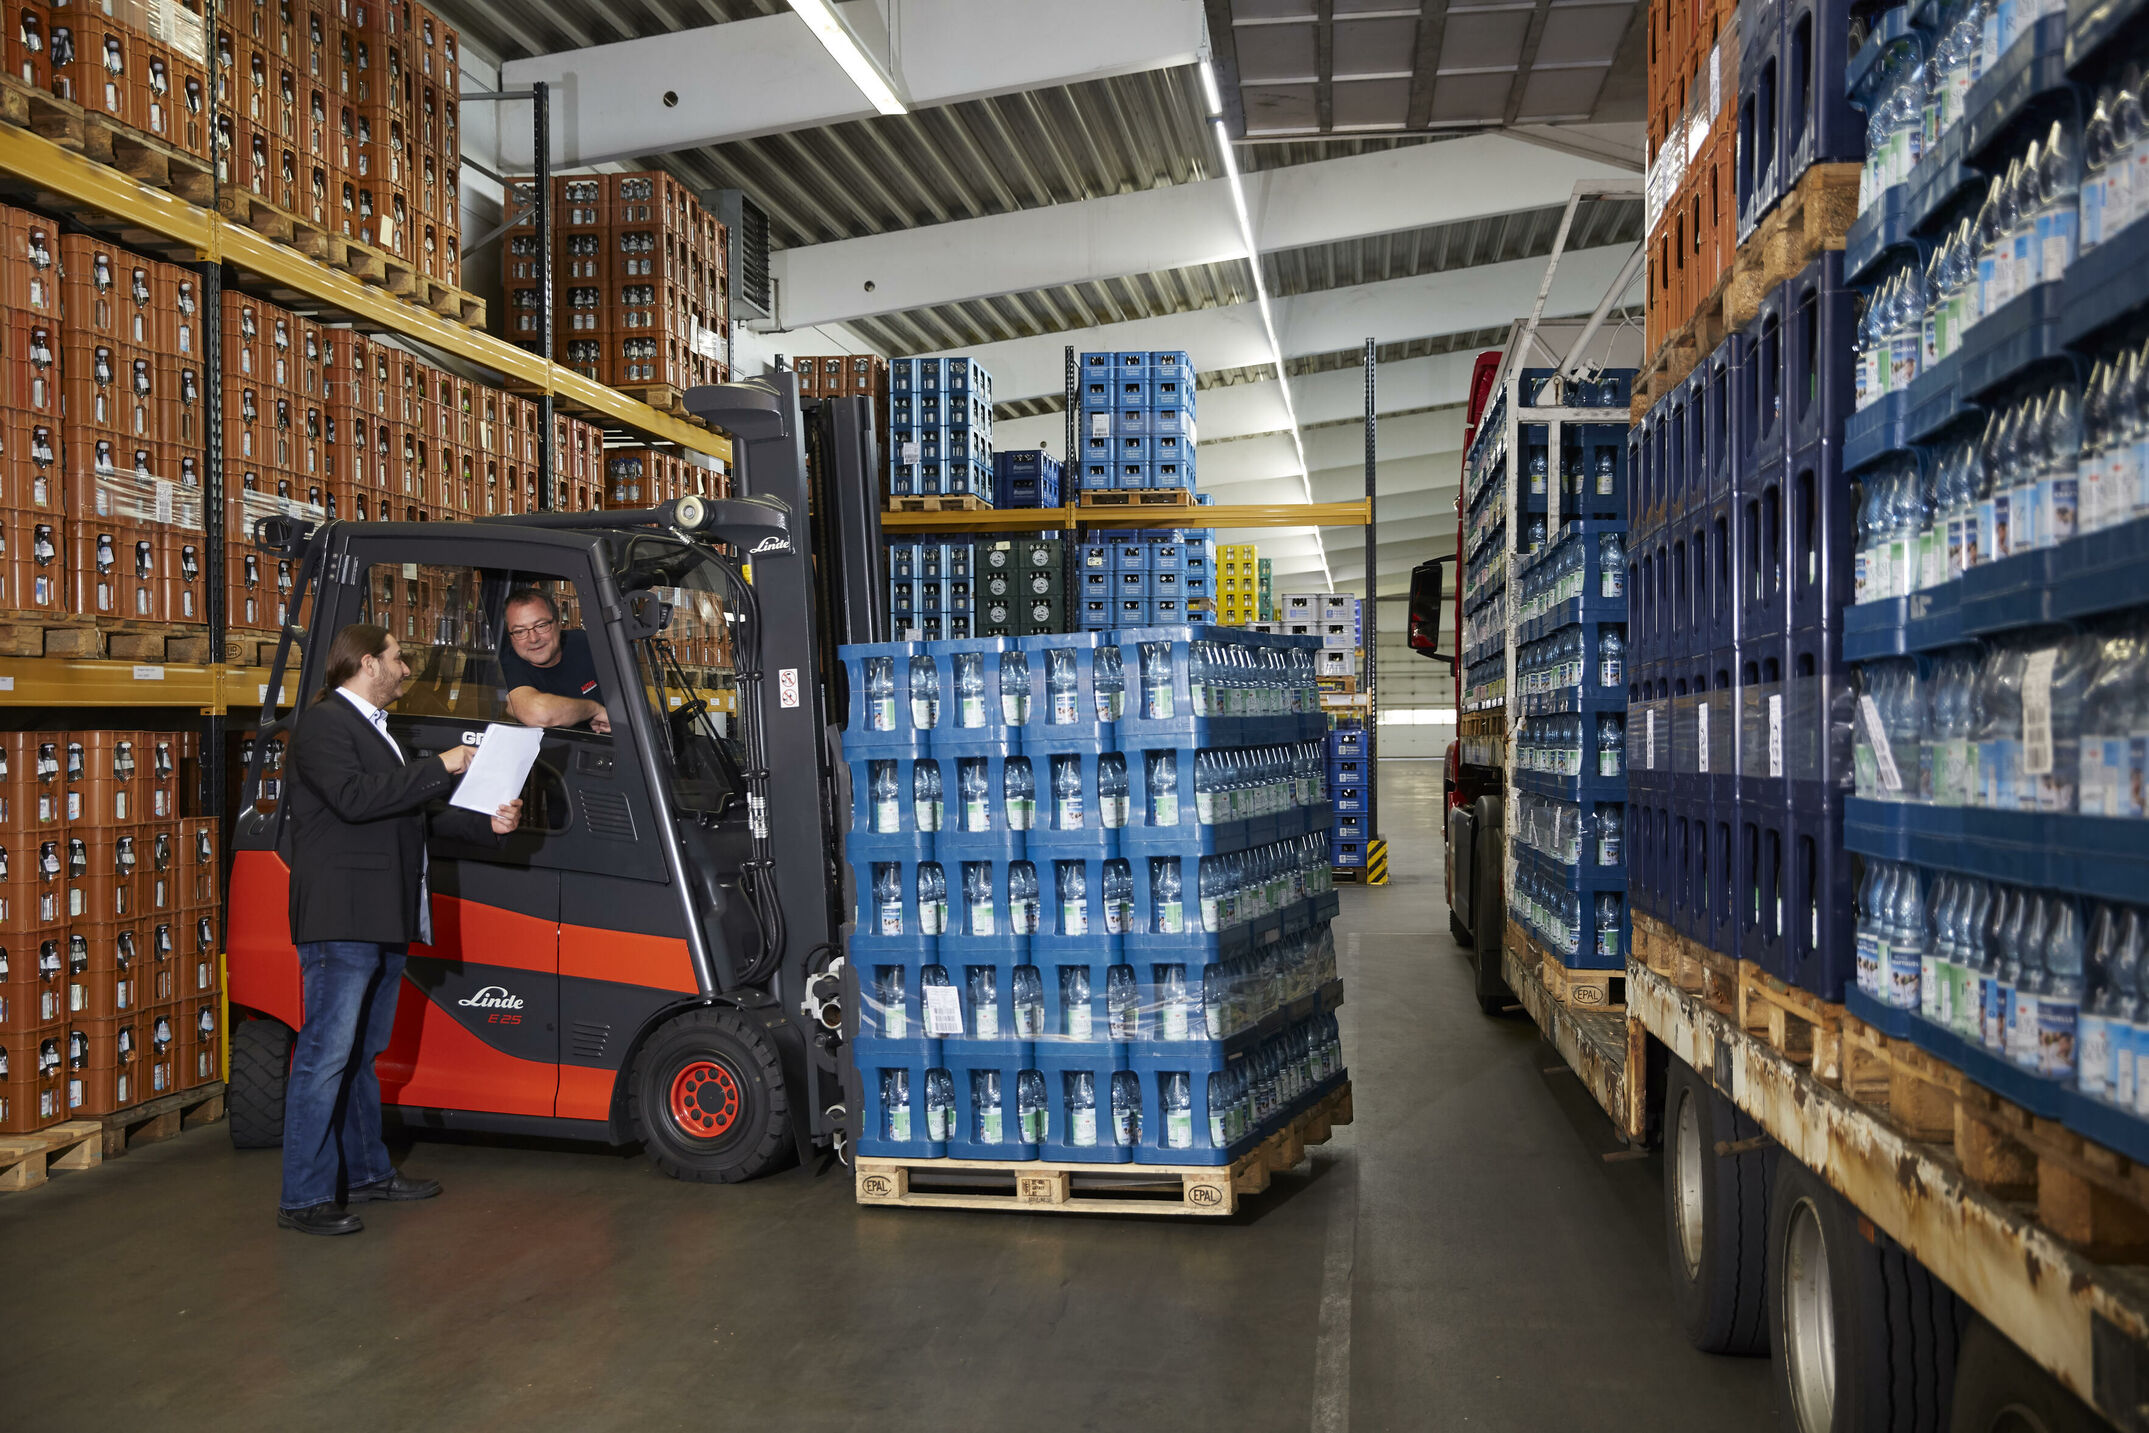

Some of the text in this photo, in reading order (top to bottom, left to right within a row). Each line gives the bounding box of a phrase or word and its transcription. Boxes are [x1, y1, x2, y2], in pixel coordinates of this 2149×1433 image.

[749, 536, 790, 553] Linde
[458, 986, 524, 1009] Linde
[1577, 989, 1598, 1000] EPAL
[488, 1014, 522, 1025] E 25
[866, 1180, 888, 1192] EPAL
[1193, 1189, 1217, 1202] EPAL
